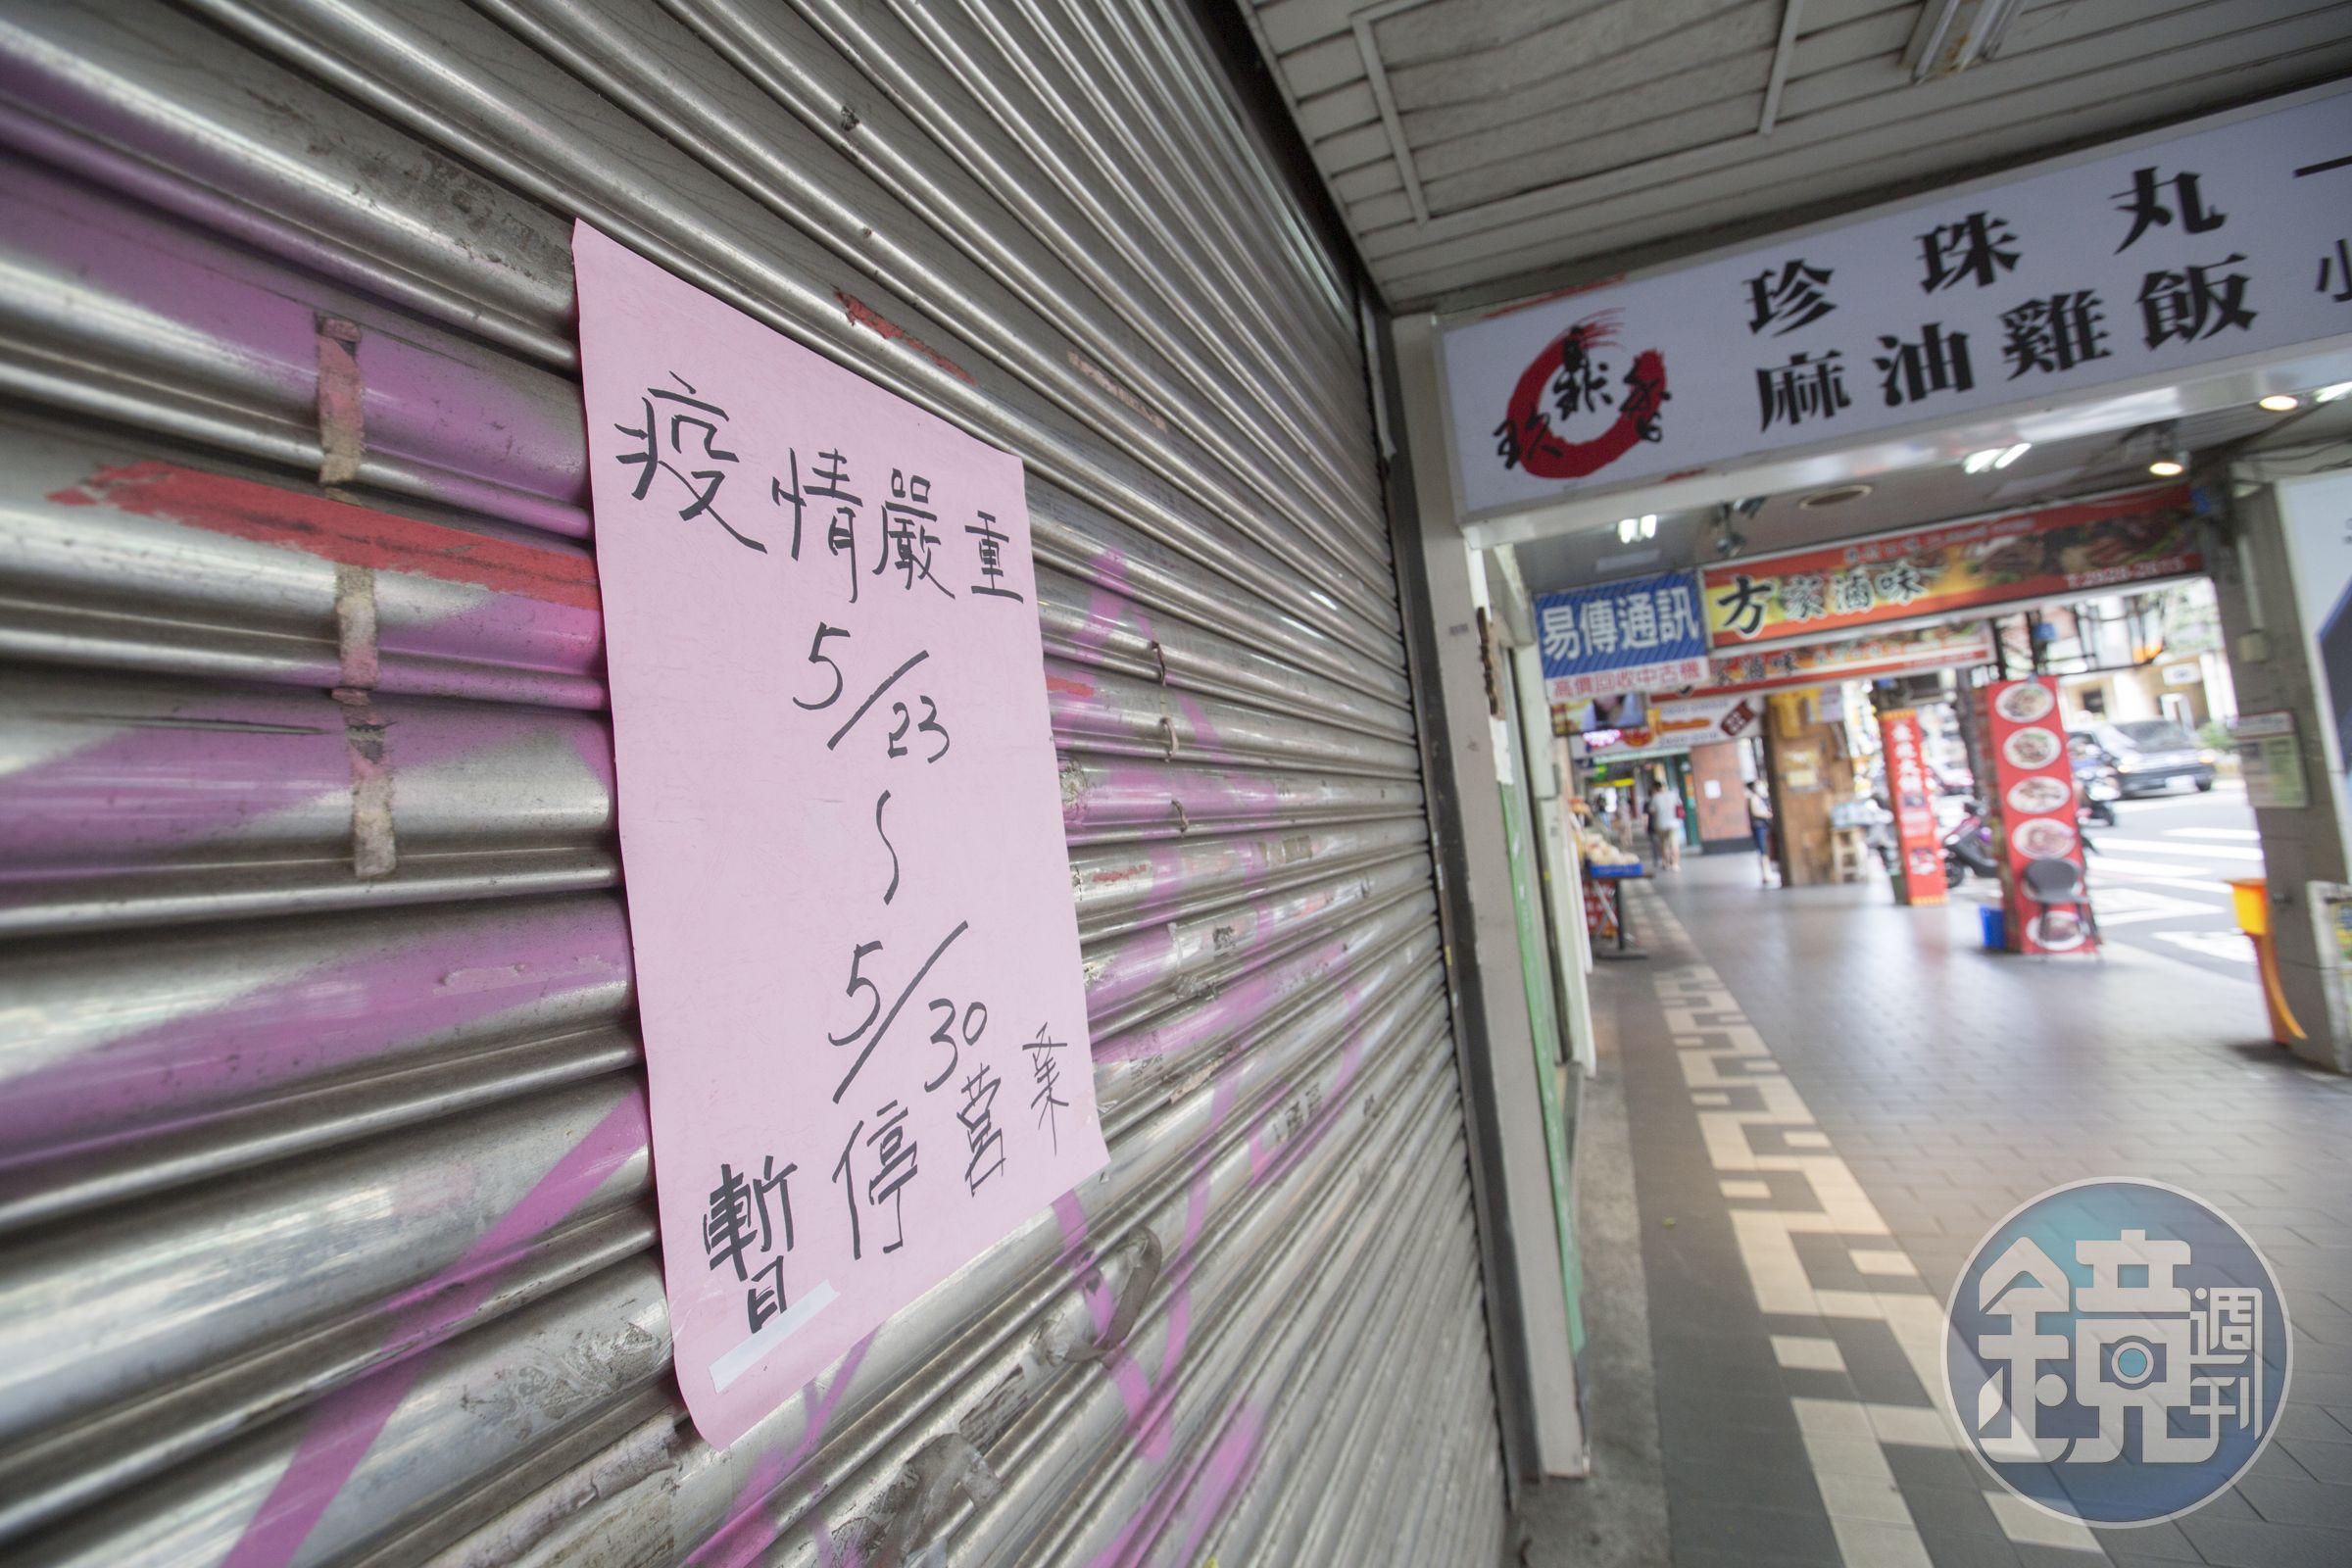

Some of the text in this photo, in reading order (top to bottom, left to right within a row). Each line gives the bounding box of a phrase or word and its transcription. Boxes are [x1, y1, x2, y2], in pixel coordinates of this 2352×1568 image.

[1741, 165, 2229, 339] 珍珠丸
[1754, 251, 2260, 434] 麻油雞飯
[612, 369, 1025, 605] 疫情嚴重
[792, 621, 952, 764] 5/23
[1542, 585, 1700, 662] 易傳通訊
[828, 920, 989, 1103] 5/30
